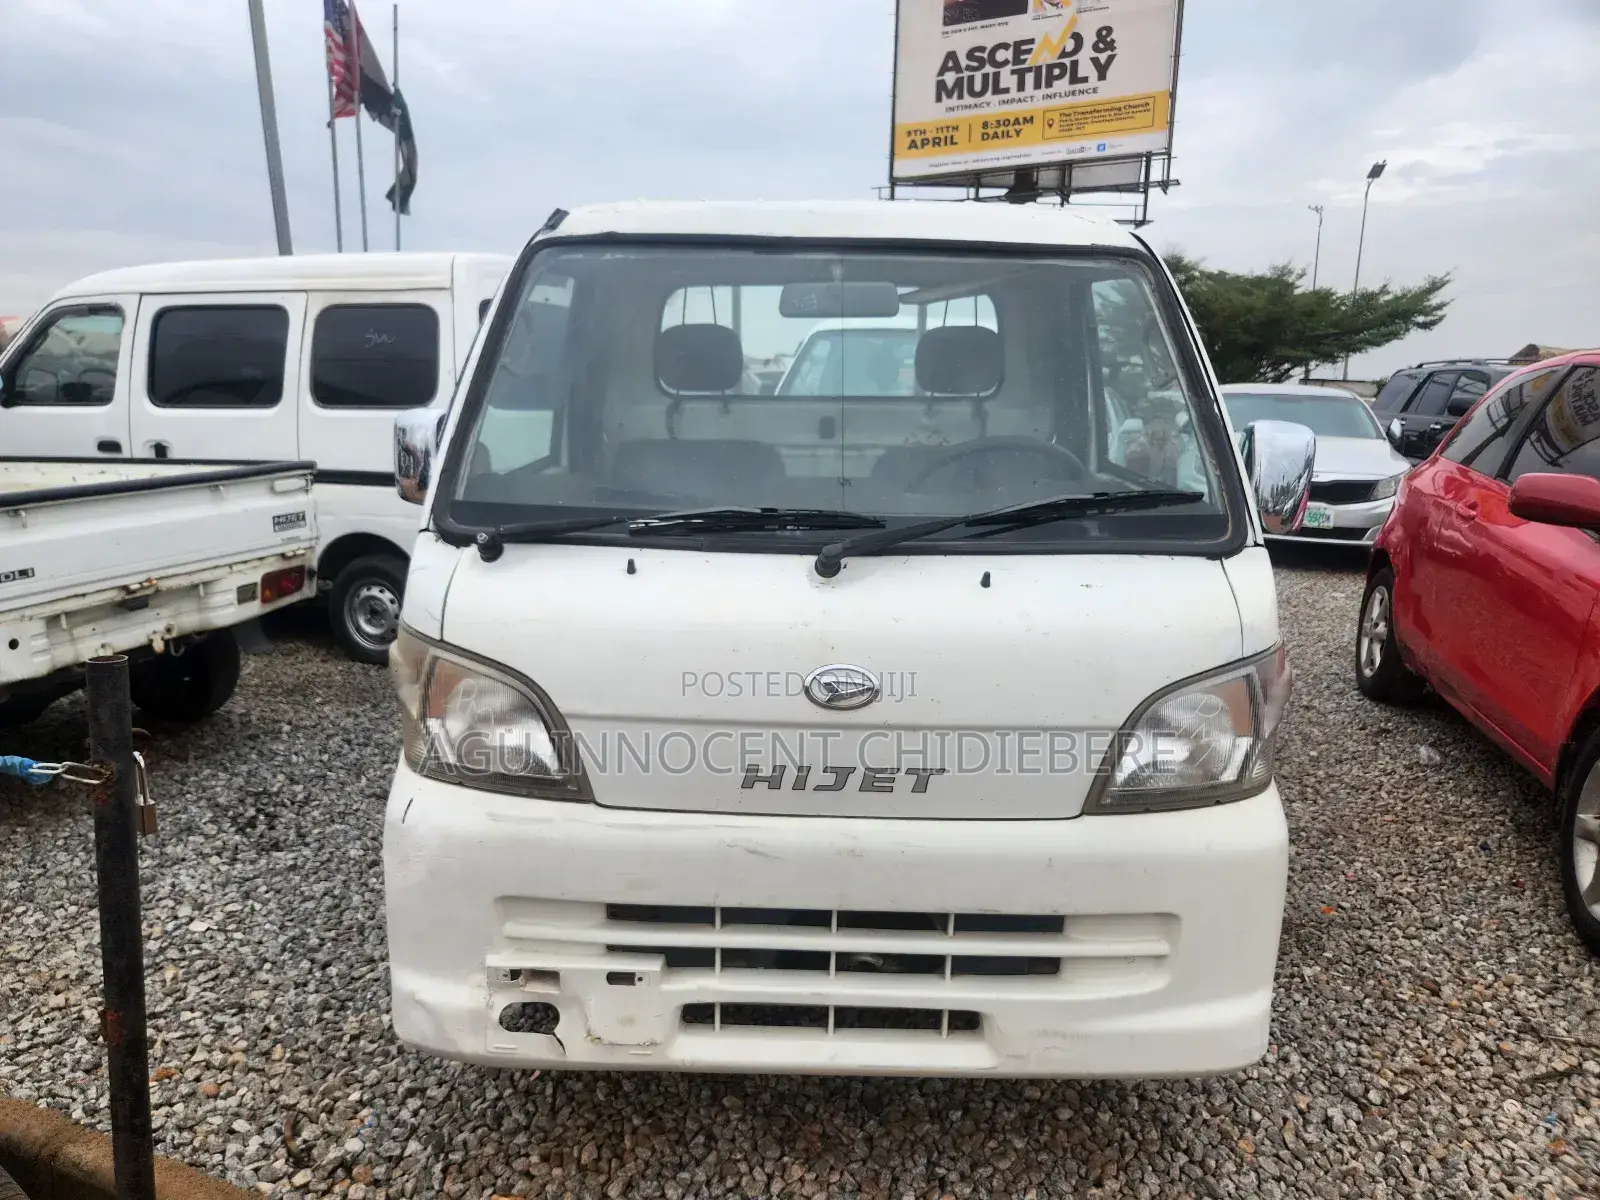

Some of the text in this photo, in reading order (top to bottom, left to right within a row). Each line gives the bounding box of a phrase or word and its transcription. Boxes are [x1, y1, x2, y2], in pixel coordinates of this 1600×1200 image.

[1091, 25, 1117, 54] &
[935, 53, 1118, 103] MULTIPLY
[945, 86, 1100, 114] INTIMACY IMPACT INFLUENCE
[981, 115, 1034, 130] 8:30AM
[981, 128, 1024, 141] DAILY
[907, 134, 959, 151] APRIL
[741, 764, 946, 793] HIJET
